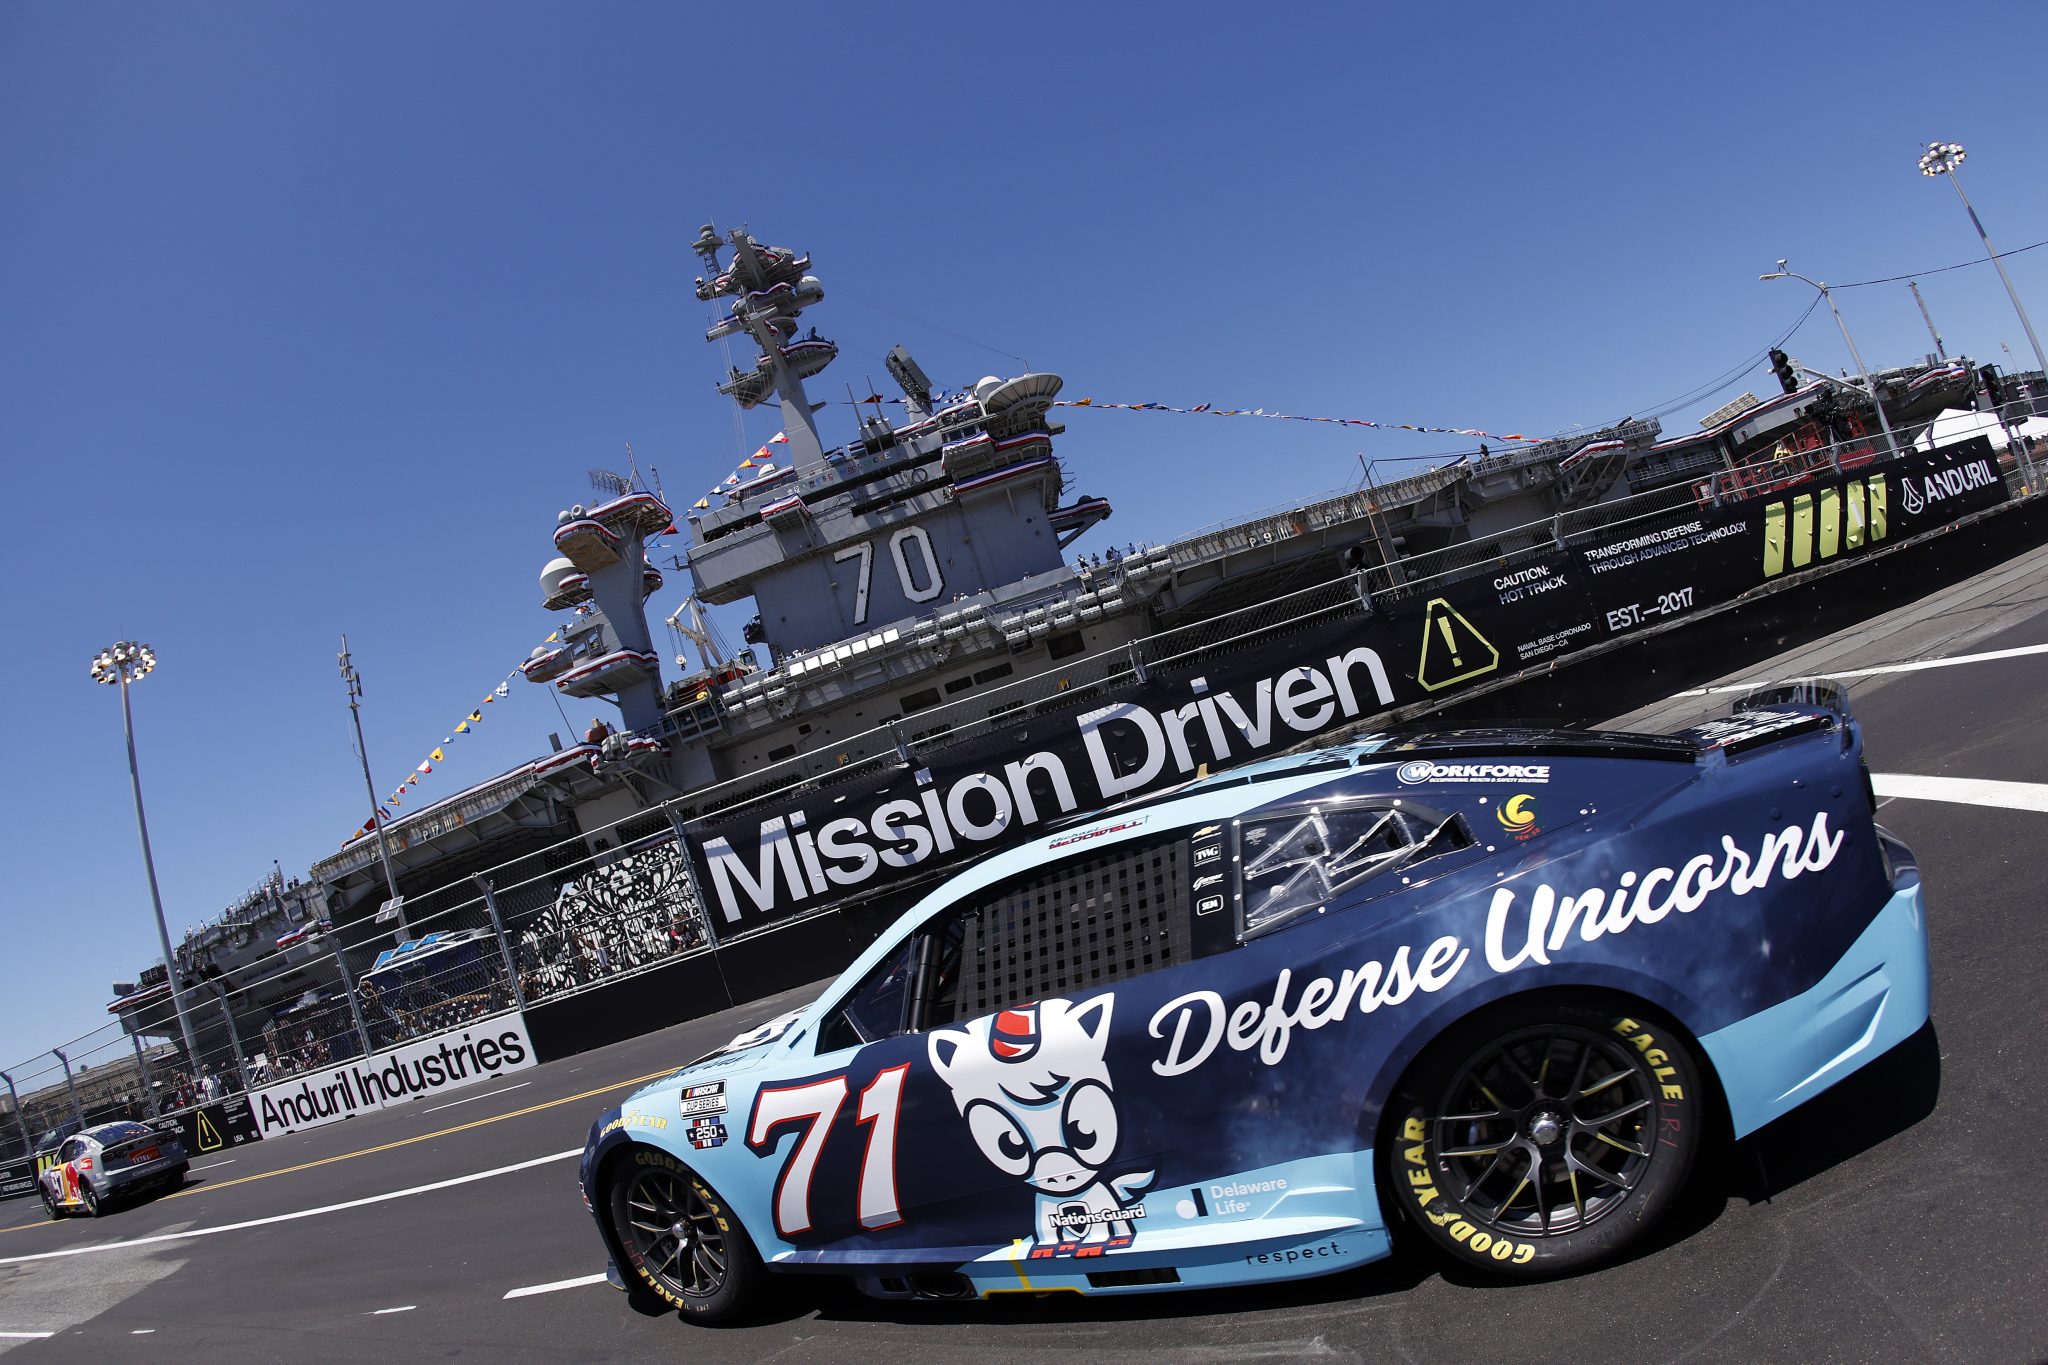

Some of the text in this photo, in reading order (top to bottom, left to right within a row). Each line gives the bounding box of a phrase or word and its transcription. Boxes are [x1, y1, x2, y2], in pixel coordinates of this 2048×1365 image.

[1924, 459, 1998, 504] ANDURIL
[1263, 531, 1273, 543] 9
[1584, 520, 1703, 562] TRANSFORMING DEFENSE
[1589, 520, 1748, 575] THROUGH ADVANCED TECHNOLOGY
[833, 525, 946, 626] 70
[1493, 565, 1551, 590] CAUTION:
[1499, 574, 1568, 605] HOT TRACK
[1517, 622, 1592, 652] NAVAL BASE CORONADO
[1520, 651, 1534, 660] SAN
[701, 646, 1395, 922] Mission Driven
[1409, 764, 1550, 778] WORKFORCE
[1195, 846, 1219, 860] TWG
[1149, 811, 1844, 1077] Defense Unicorns
[1612, 1017, 1684, 1101] EAGLE
[261, 1070, 358, 1132] Anduril
[352, 1031, 526, 1106] Industries
[692, 1083, 720, 1096] NASCAR
[686, 1097, 720, 1112] CUP SERIES
[600, 1109, 669, 1139] GOODYEAR
[696, 1125, 718, 1139] 250
[133, 1153, 151, 1165] EXTRA
[750, 1061, 912, 1237] 71
[1210, 1176, 1288, 1200] Delaware
[1403, 1116, 1537, 1265] GOODYEAR
[1048, 1203, 1147, 1230] NationsGuard
[1214, 1200, 1247, 1217] Life
[1245, 1242, 1349, 1267] respect.
[638, 1266, 684, 1310] EAGLE
